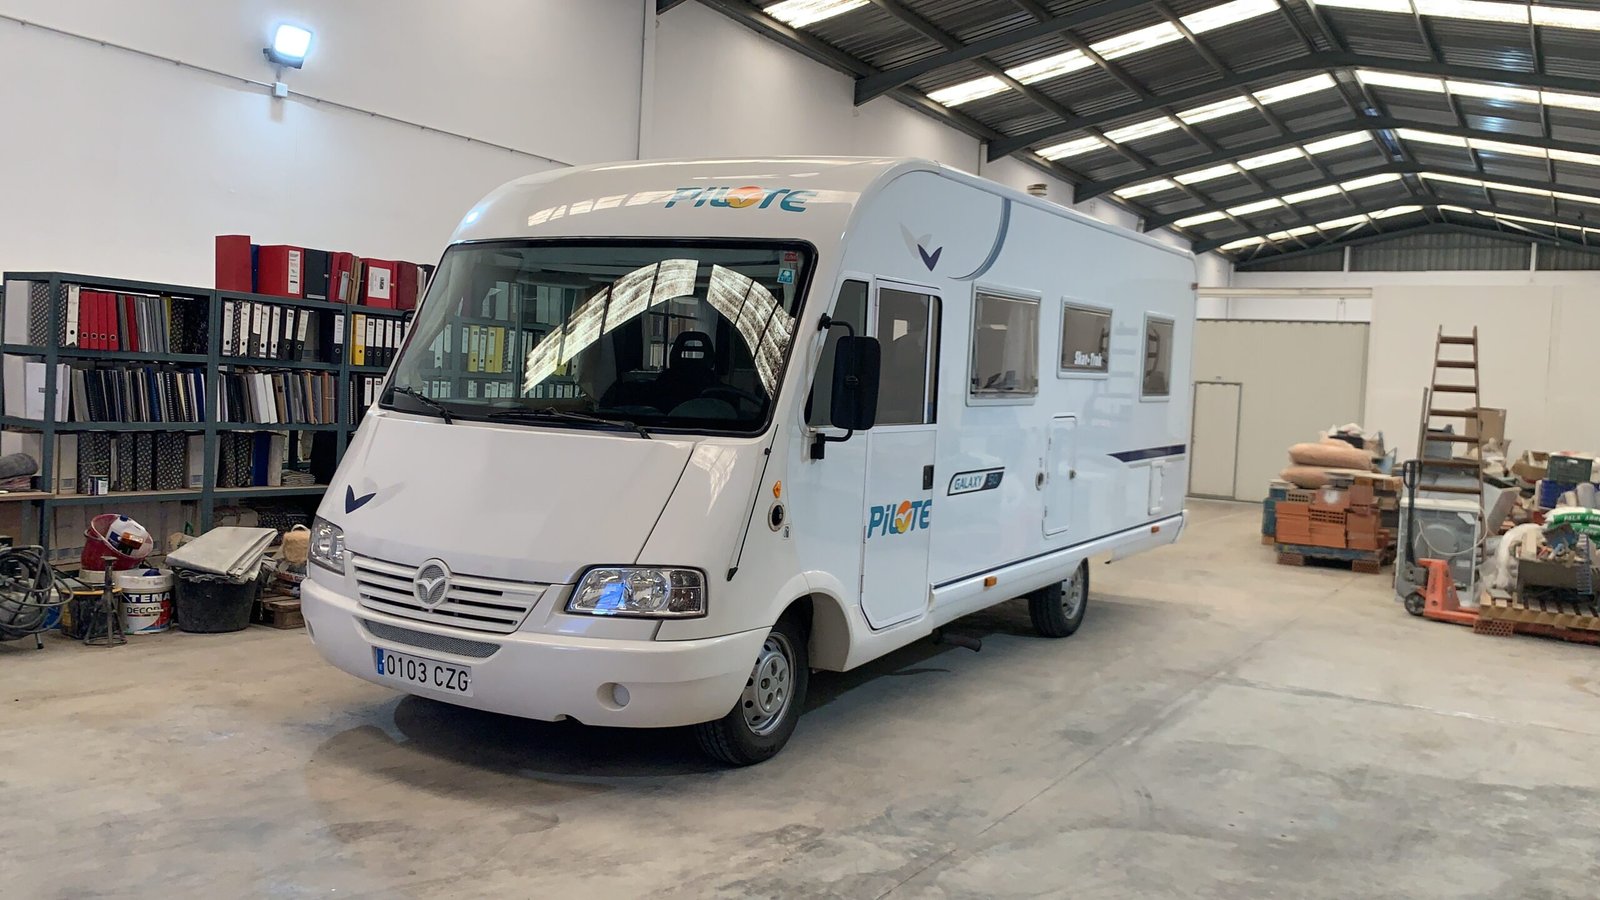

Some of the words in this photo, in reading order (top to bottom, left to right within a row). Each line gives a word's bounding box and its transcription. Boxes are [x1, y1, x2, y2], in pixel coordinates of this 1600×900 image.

[954, 475, 982, 490] GALAXY
[386, 655, 427, 683] 0103
[434, 666, 468, 691] CZG
